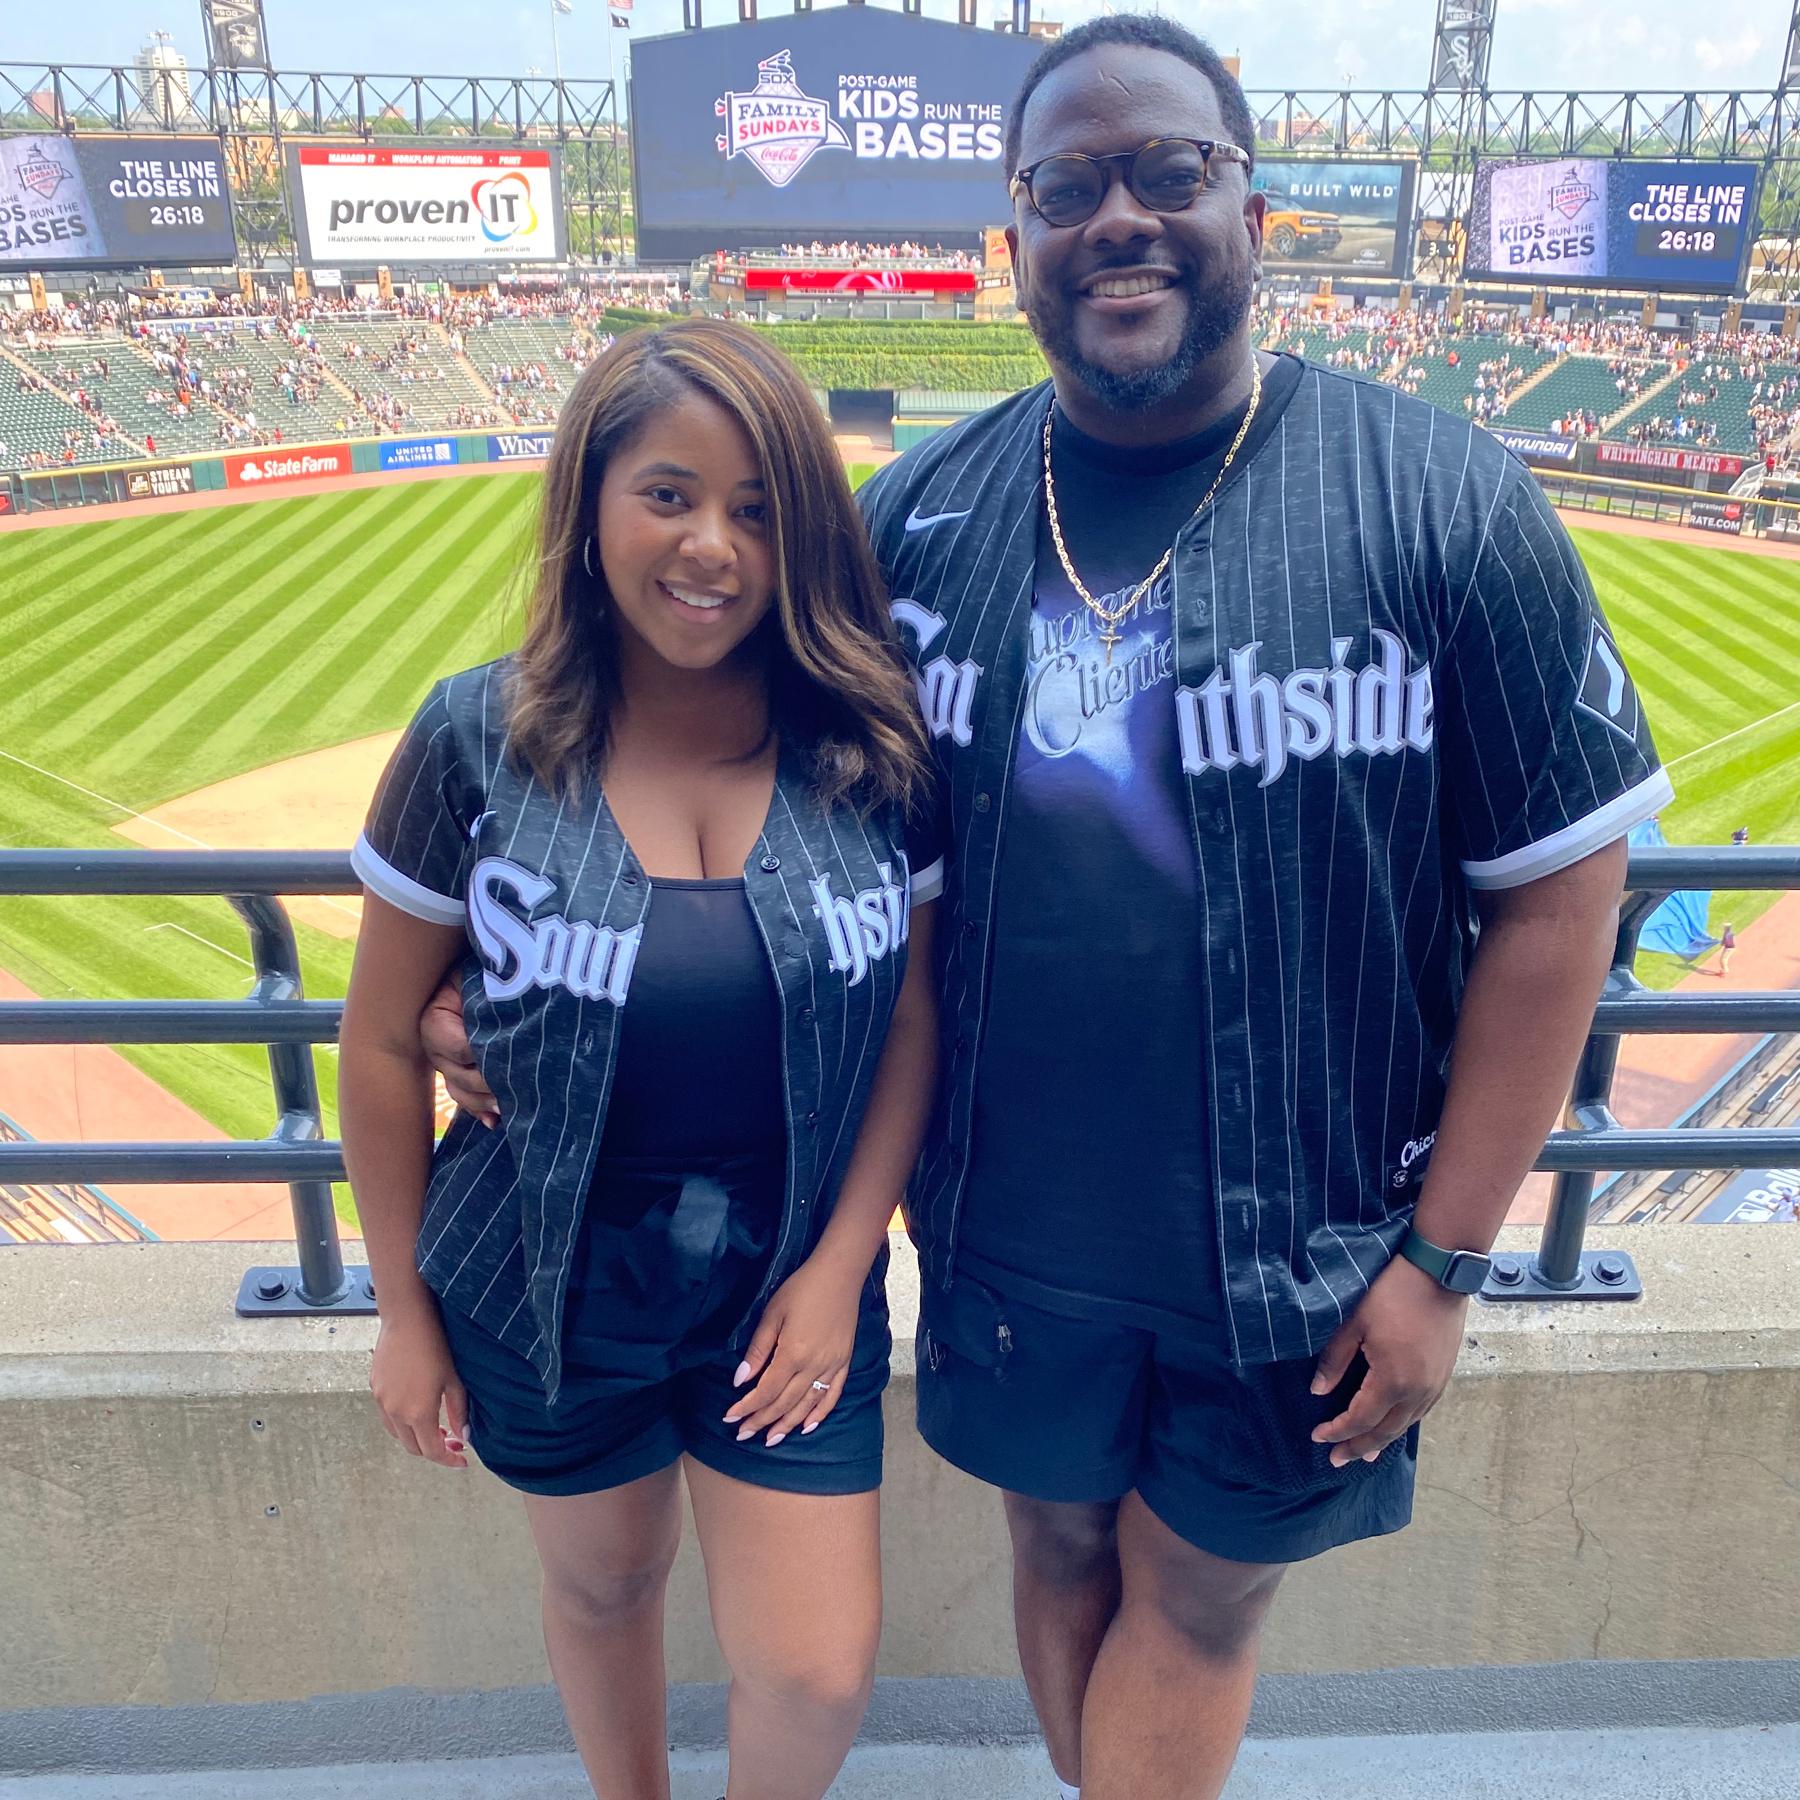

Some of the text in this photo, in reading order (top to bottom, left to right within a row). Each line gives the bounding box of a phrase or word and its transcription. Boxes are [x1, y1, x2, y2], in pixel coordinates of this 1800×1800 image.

[760, 73, 795, 84] SOX
[838, 75, 917, 88] POST-GAME
[738, 102, 820, 120] FAMILY
[838, 89, 1002, 120] KIDS RUN THE
[739, 119, 820, 140] SUNDAYS
[856, 121, 1003, 161] BASES
[120, 161, 218, 179] THE LINE
[109, 179, 220, 197] CLOSES IN
[1290, 184, 1342, 197] BUILT
[1647, 184, 1746, 205] THE LINE
[29, 207, 54, 219] RUN
[57, 202, 79, 214] THE
[150, 206, 204, 225] 26:18
[329, 194, 519, 231] proven IT
[1628, 202, 1742, 224] CLOSES IN
[1500, 222, 1595, 244] KIDS RUN THE
[1658, 230, 1716, 251] 26:18
[1509, 235, 1596, 265] BASES
[395, 446, 433, 455] UNITED
[496, 435, 554, 455] WINT
[1505, 436, 1569, 454] HYUNDAI
[387, 453, 434, 464] AIRLINES
[1601, 445, 1679, 468] WHITTINGHAM
[1682, 454, 1720, 473] MEATS
[150, 467, 190, 482] STREAM
[152, 481, 179, 496] YOUR
[1690, 515, 1741, 530] RATE.COM
[1029, 575, 1172, 664] upreme
[808, 850, 911, 987] hsi
